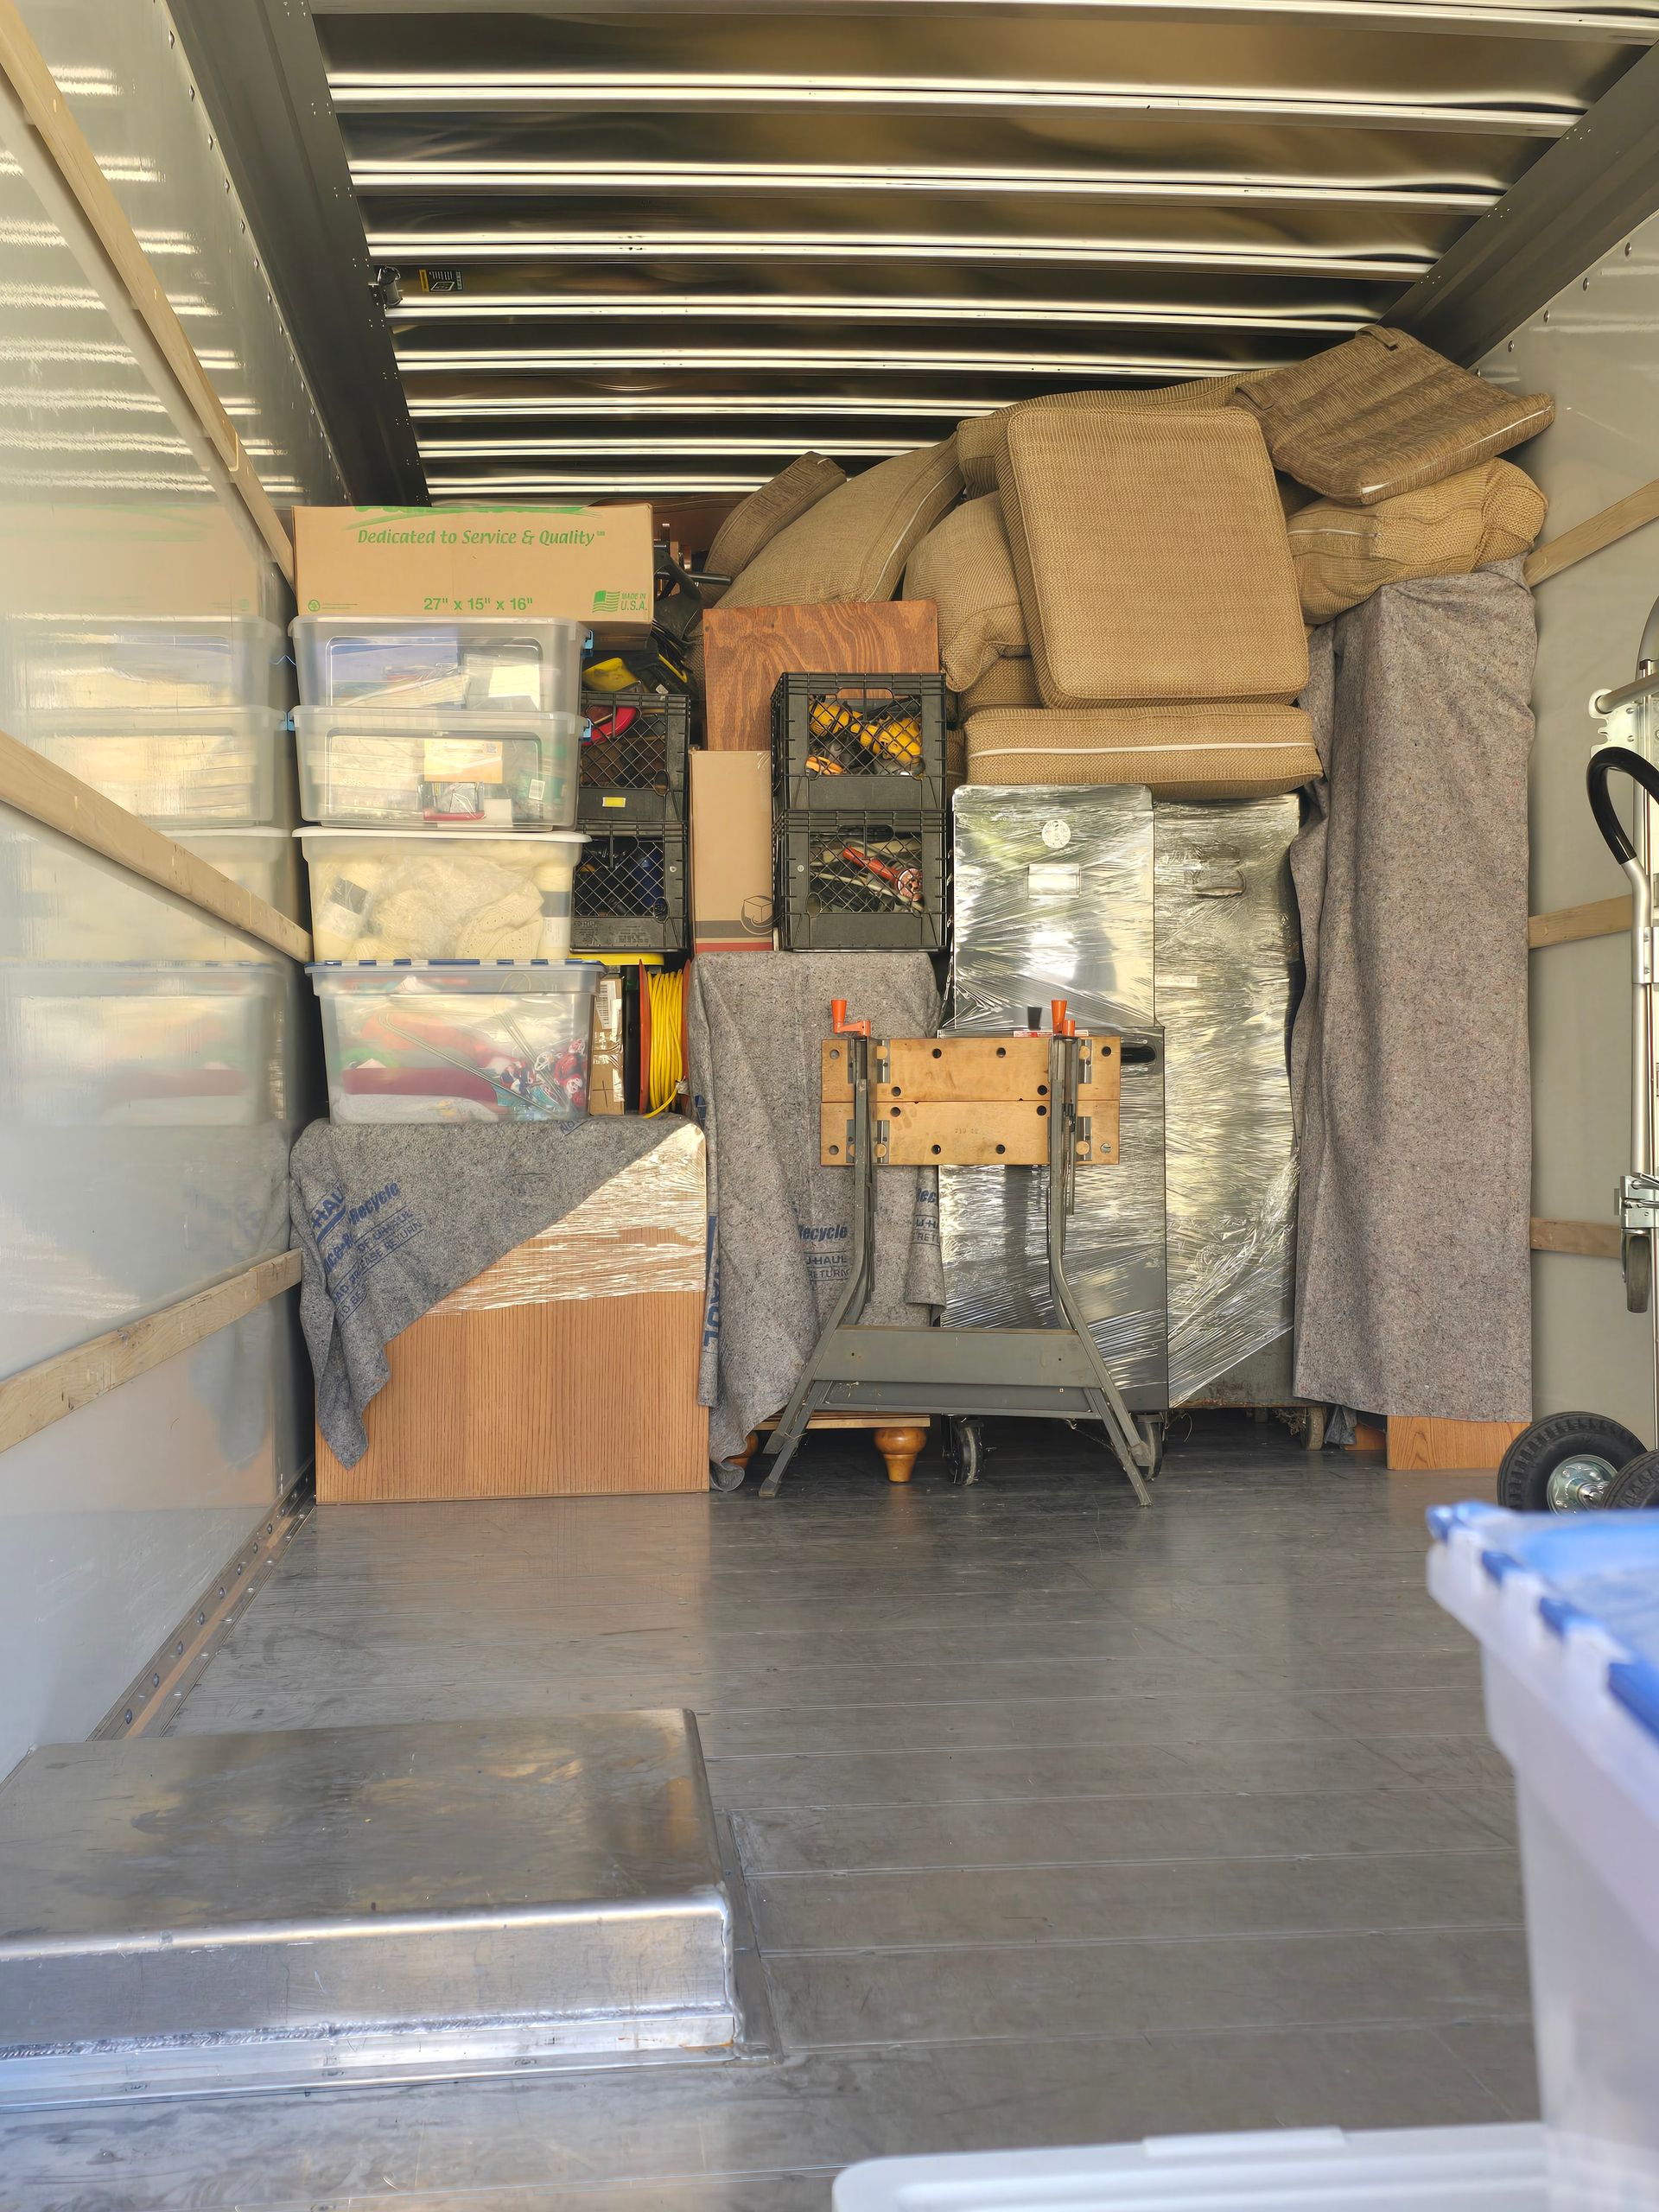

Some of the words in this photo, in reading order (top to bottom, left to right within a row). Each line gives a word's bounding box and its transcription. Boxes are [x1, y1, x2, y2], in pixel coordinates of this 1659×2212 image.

[357, 529, 435, 544] Dedicated
[441, 531, 457, 544] to
[461, 529, 517, 544] Service
[521, 530, 535, 545] &
[539, 529, 594, 547] Quality
[423, 598, 448, 610] 27"
[454, 601, 463, 610] x
[467, 598, 490, 610] 15"
[496, 601, 505, 610] x
[510, 598, 533, 610] 16"
[620, 600, 648, 611] U.S.A.
